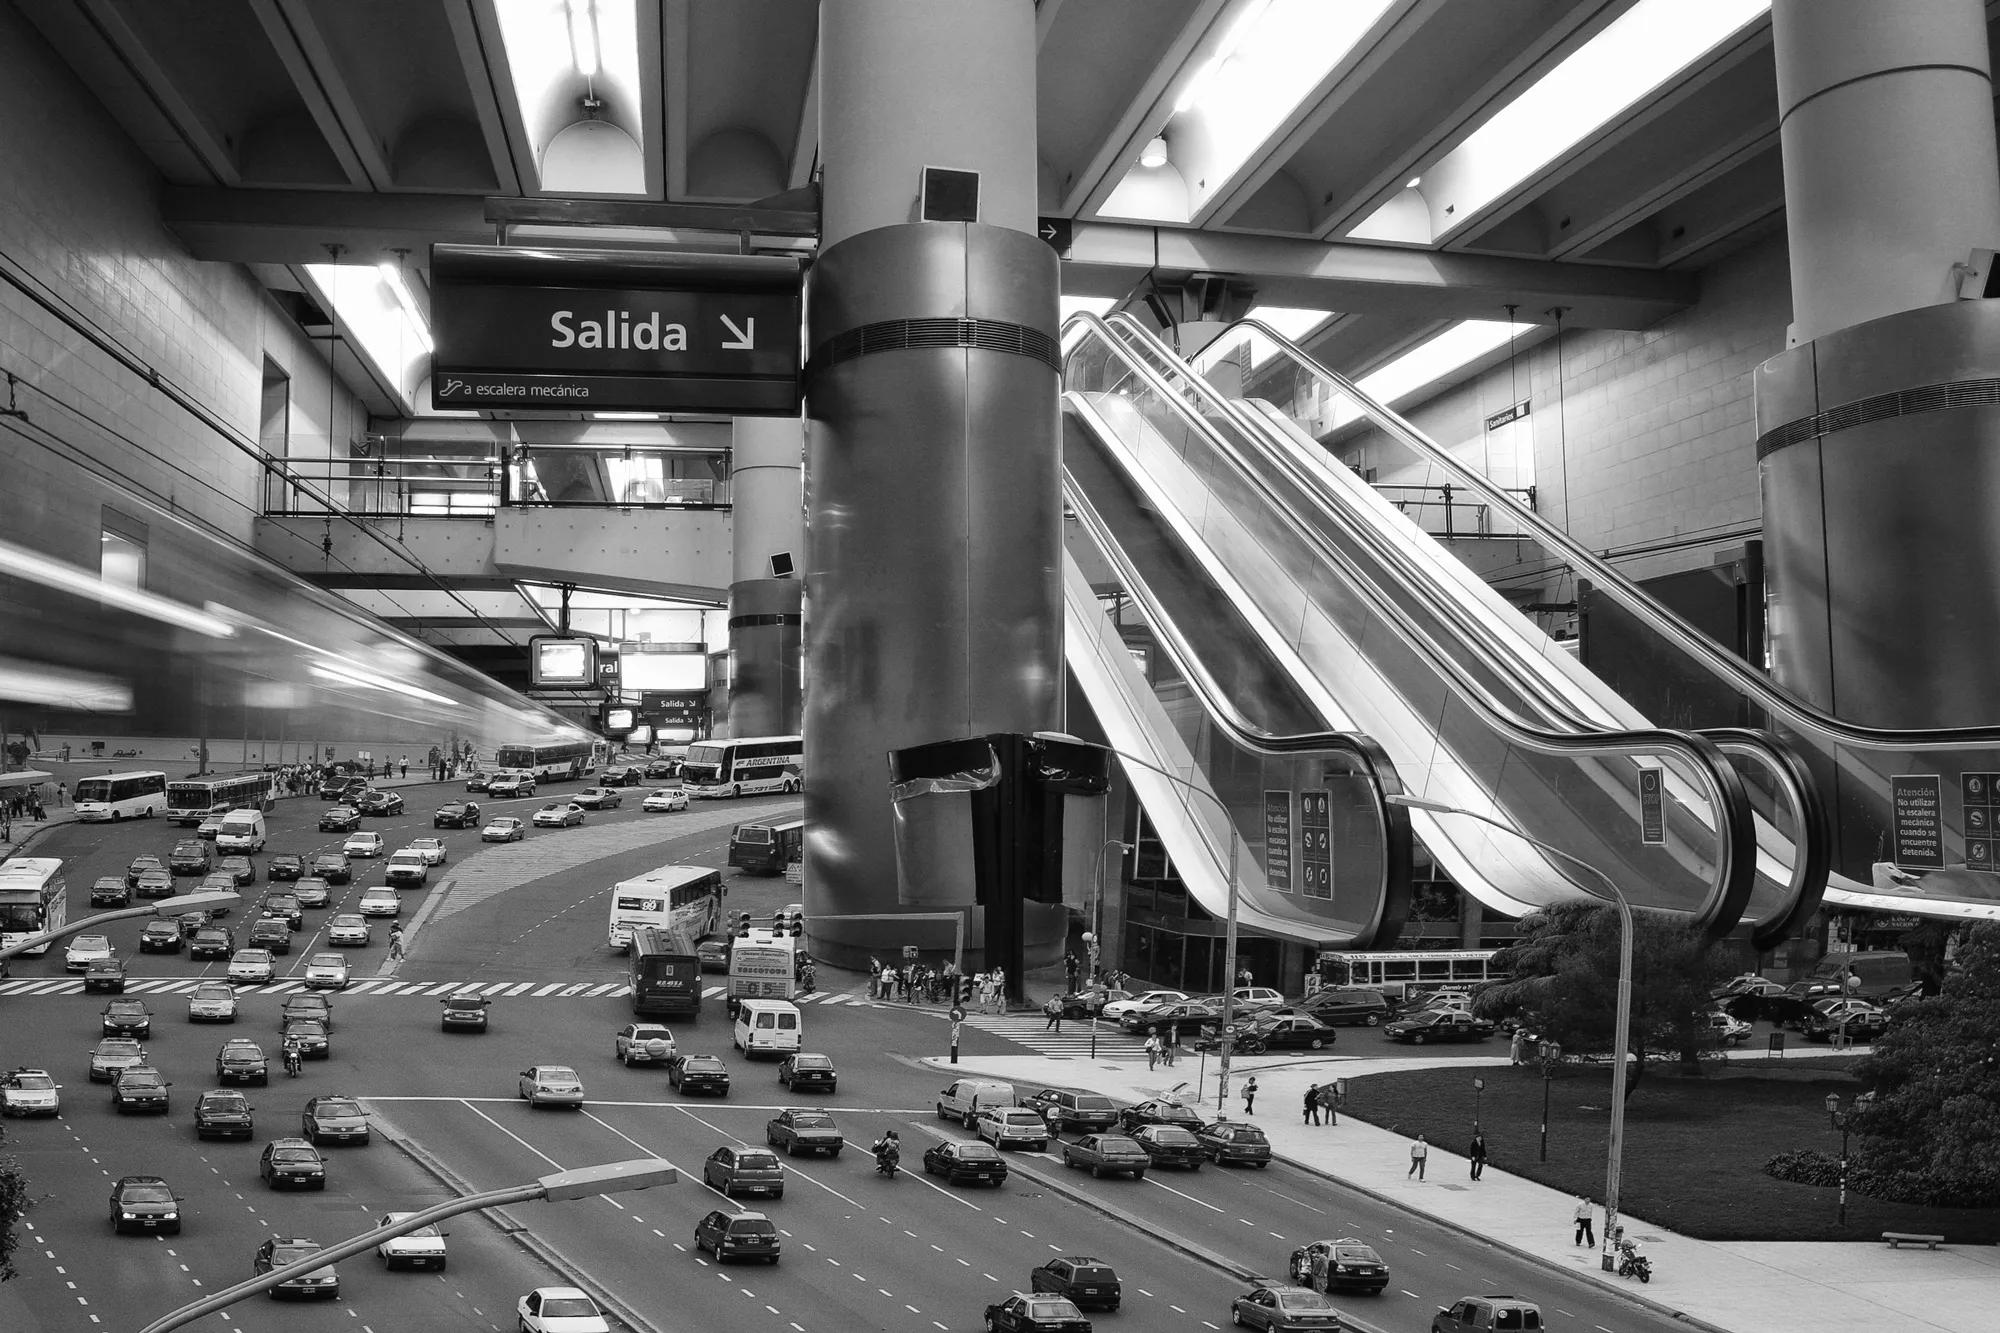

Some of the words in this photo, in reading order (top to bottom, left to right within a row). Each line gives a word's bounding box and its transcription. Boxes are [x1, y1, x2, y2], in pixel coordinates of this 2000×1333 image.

[551, 310, 687, 351] Salida
[464, 385, 472, 395] a
[476, 383, 526, 396] escalera
[530, 384, 590, 397] mecánica
[660, 700, 685, 708] Salida
[746, 756, 790, 767] ARGENTINA
[1897, 788, 1935, 796] Atención
[1897, 798, 1908, 806] No
[1910, 798, 1935, 806] utilizar
[1906, 808, 1936, 816] escalera
[1901, 817, 1935, 826] mecánica
[1900, 828, 1927, 836] cuando
[1901, 839, 1937, 847] encuentre
[1902, 848, 1936, 857] detenida.
